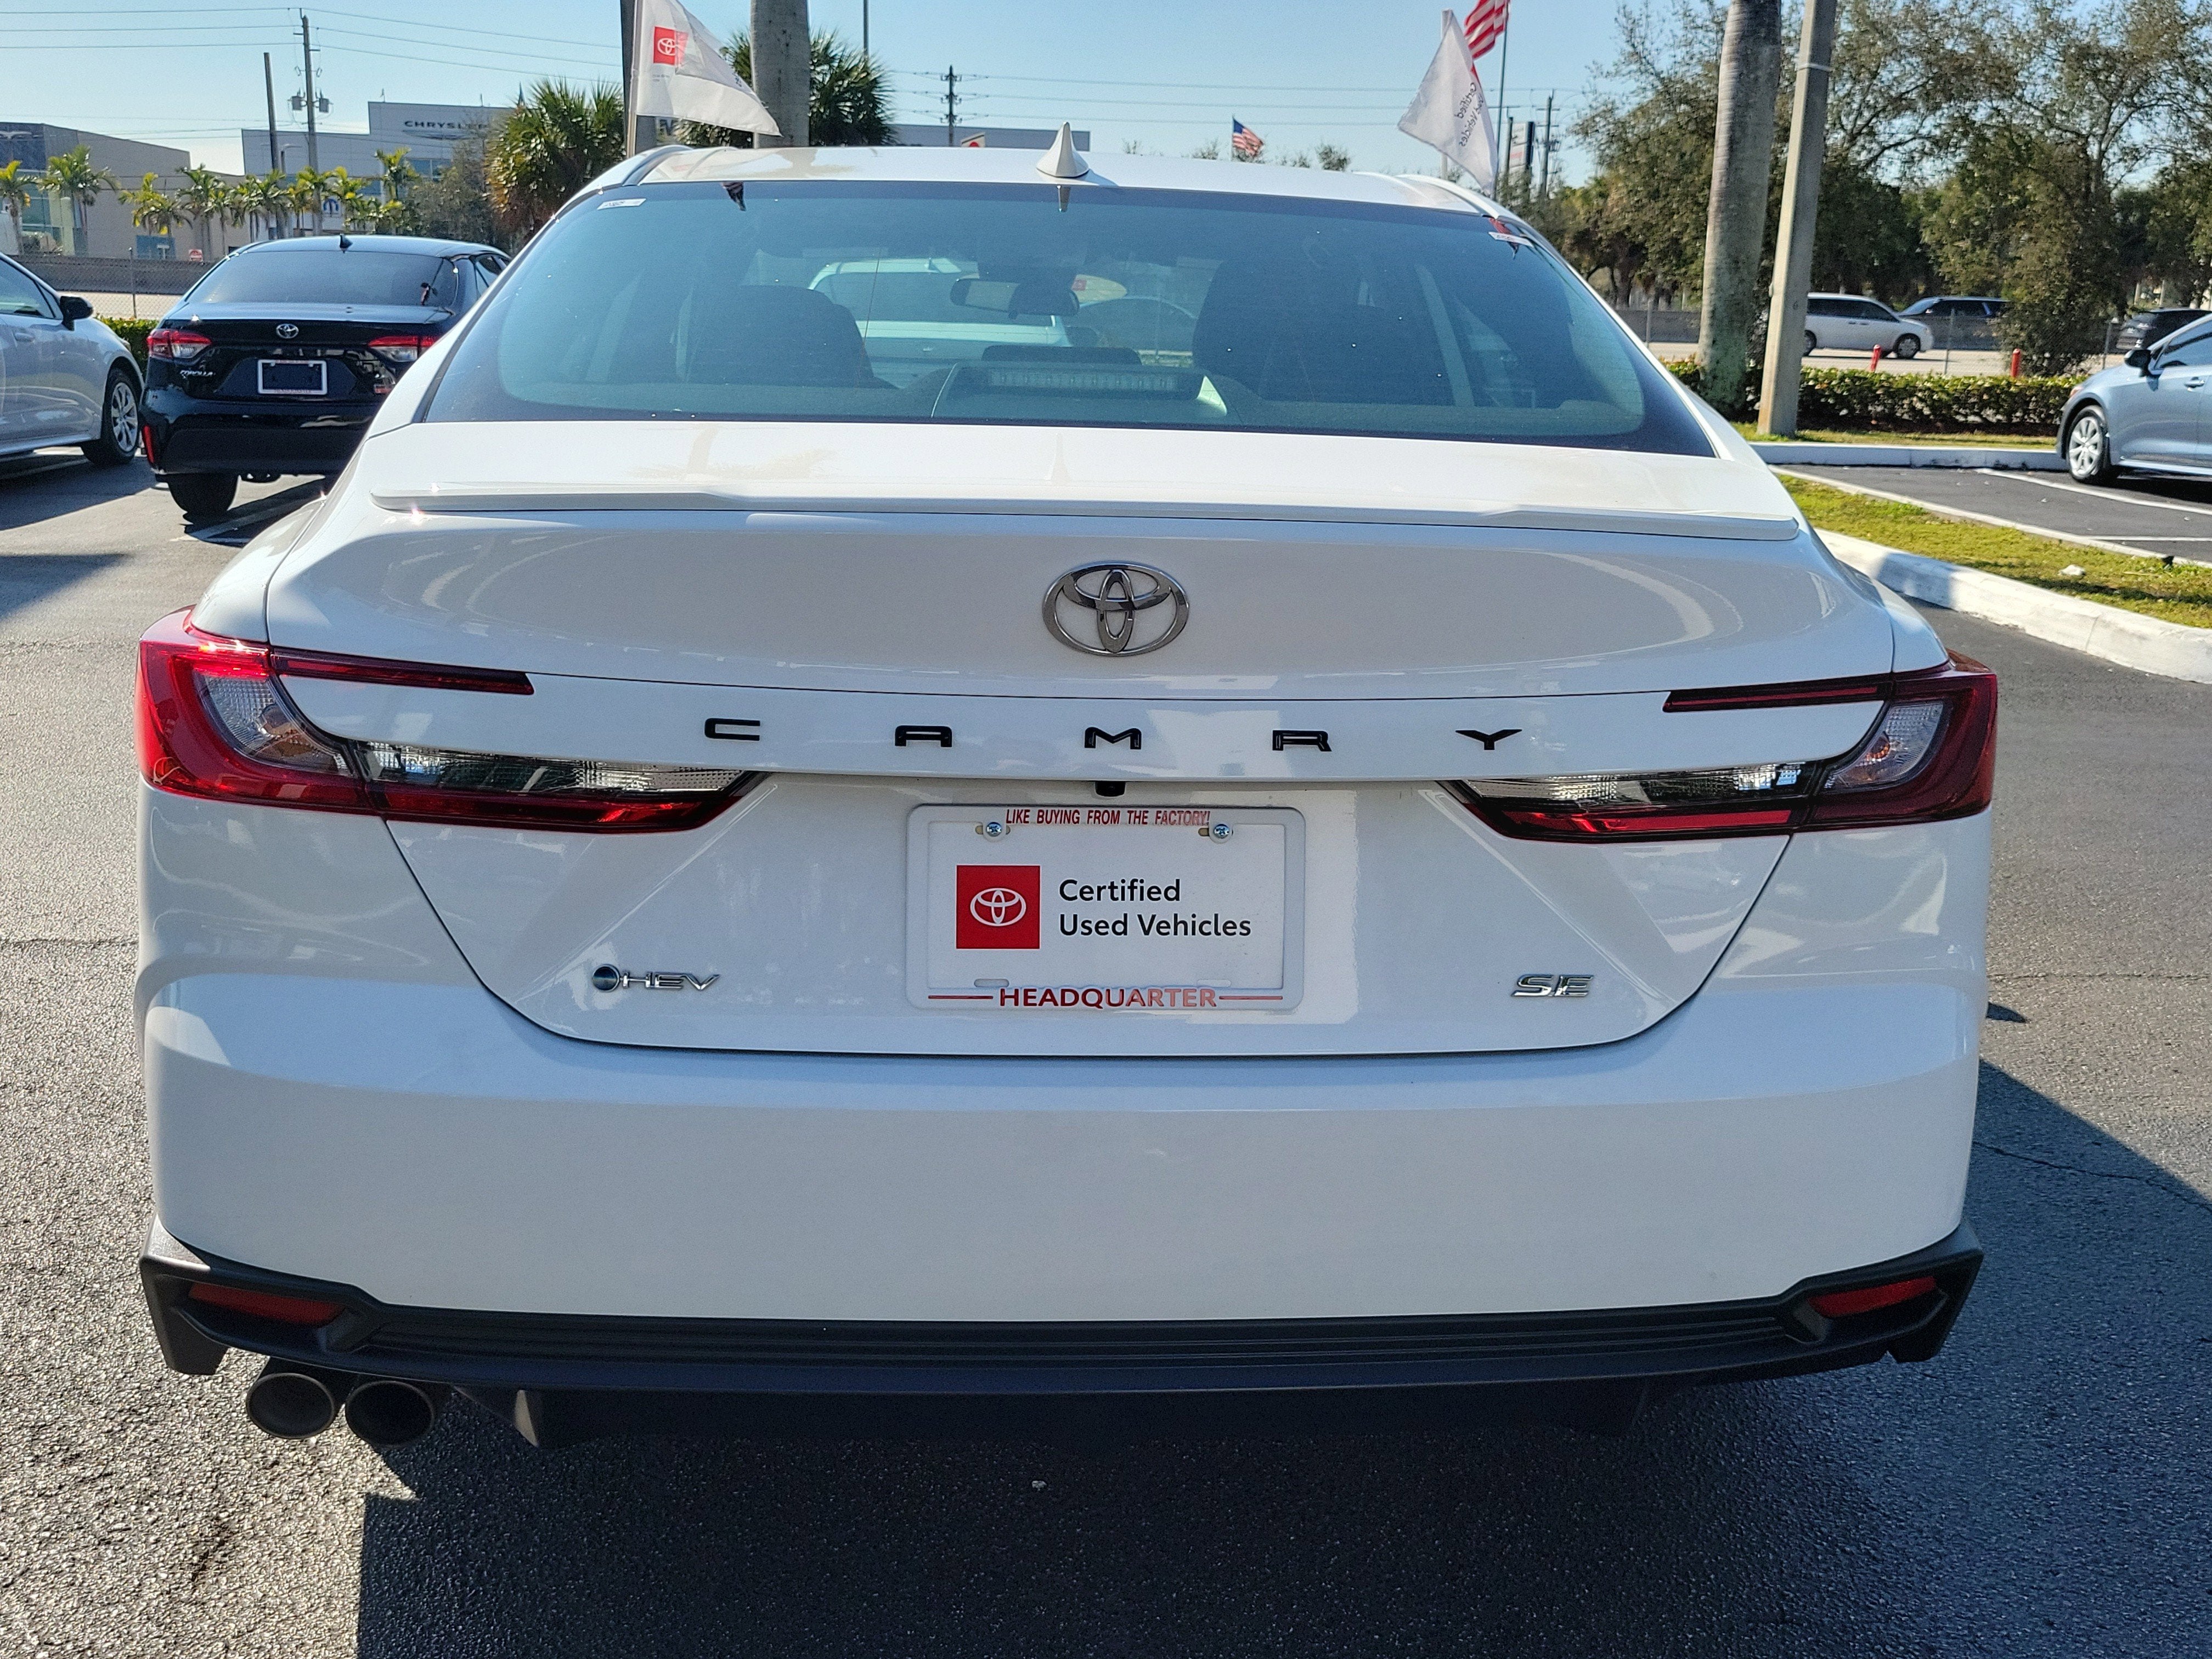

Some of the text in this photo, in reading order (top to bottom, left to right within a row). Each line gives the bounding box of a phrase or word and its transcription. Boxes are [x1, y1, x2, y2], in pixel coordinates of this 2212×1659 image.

[704, 718, 1523, 752] CAMRY
[1006, 809, 1211, 826] LIKE BUYING FROM THE FACTORY!
[1059, 878, 1180, 901] Certified
[1060, 913, 1251, 936] Used Vehicles
[622, 971, 721, 991] HEV
[1510, 973, 1594, 998] SE
[1000, 988, 1217, 1009] HEADQUARTER
